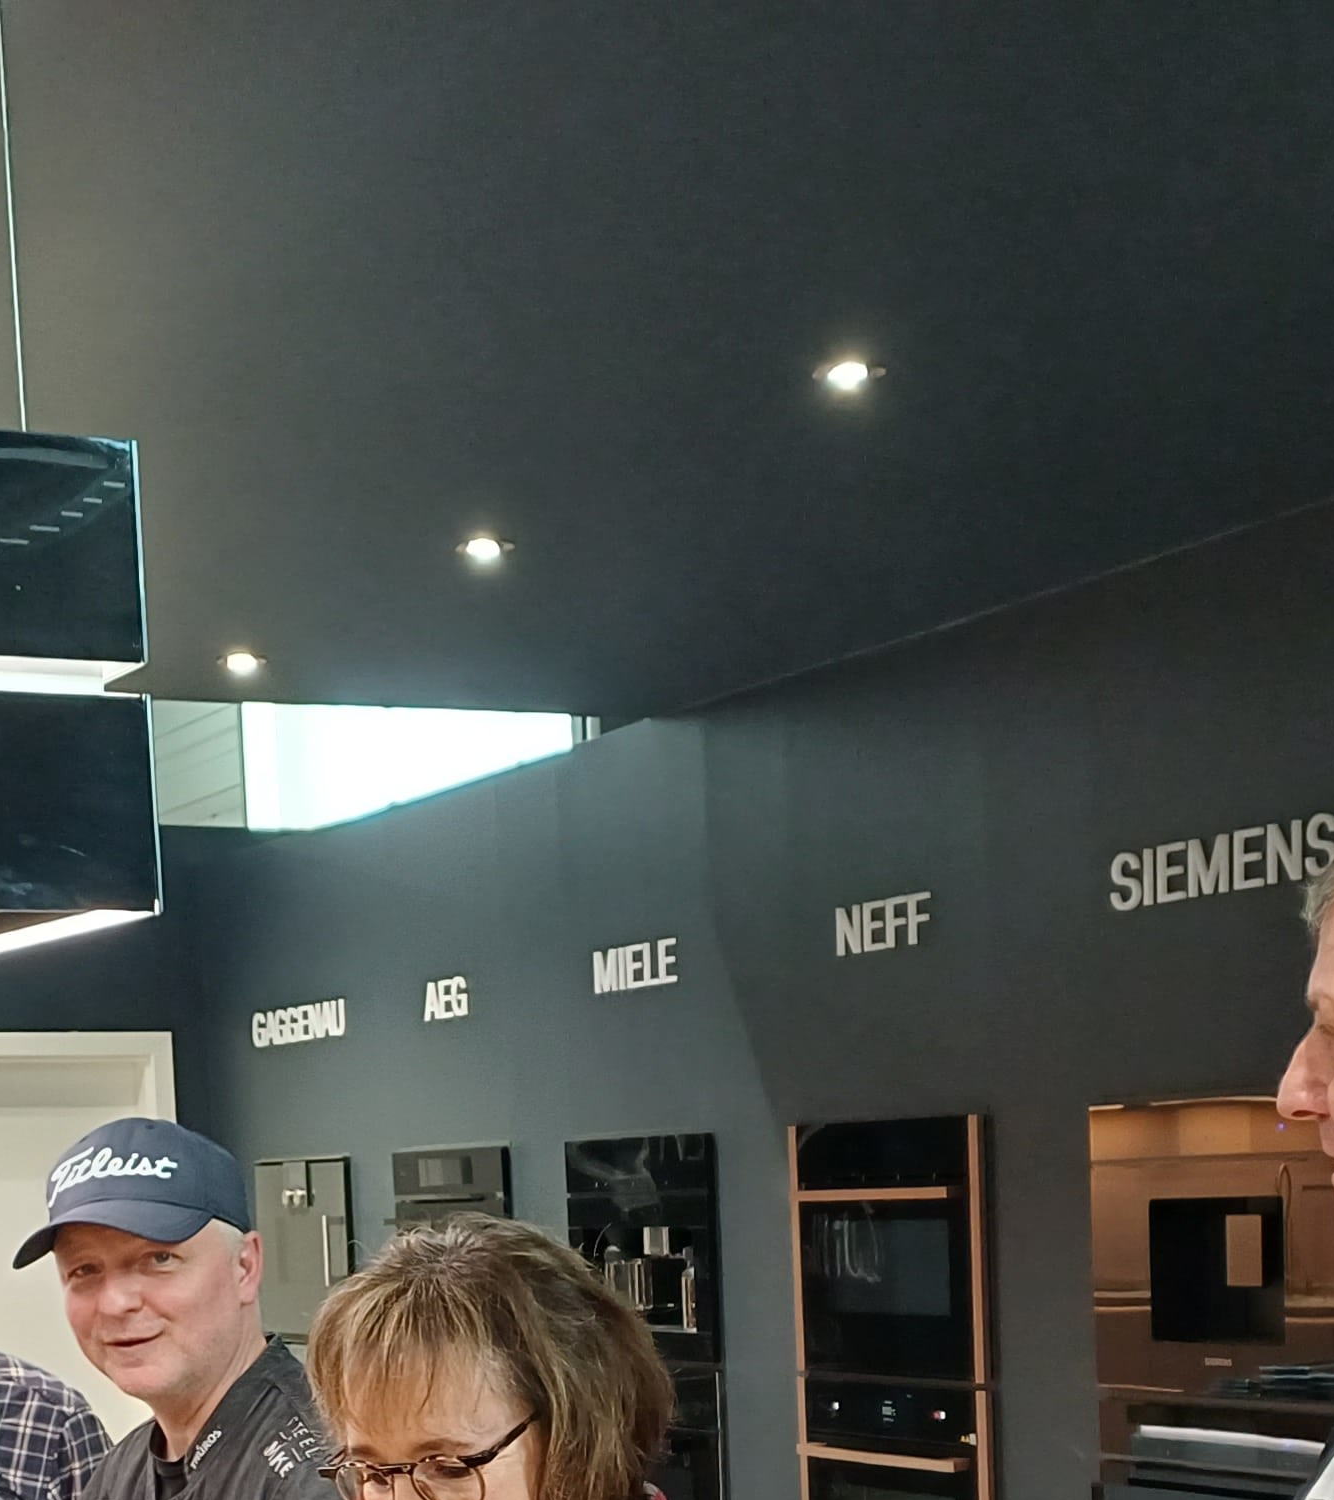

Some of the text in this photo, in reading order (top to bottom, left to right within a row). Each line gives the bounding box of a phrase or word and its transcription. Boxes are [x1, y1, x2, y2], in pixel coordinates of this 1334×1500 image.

[835, 891, 931, 956] NEFF
[593, 937, 678, 994] MIELE
[252, 998, 346, 1048] GAGGENAU
[424, 976, 468, 1022] AEG
